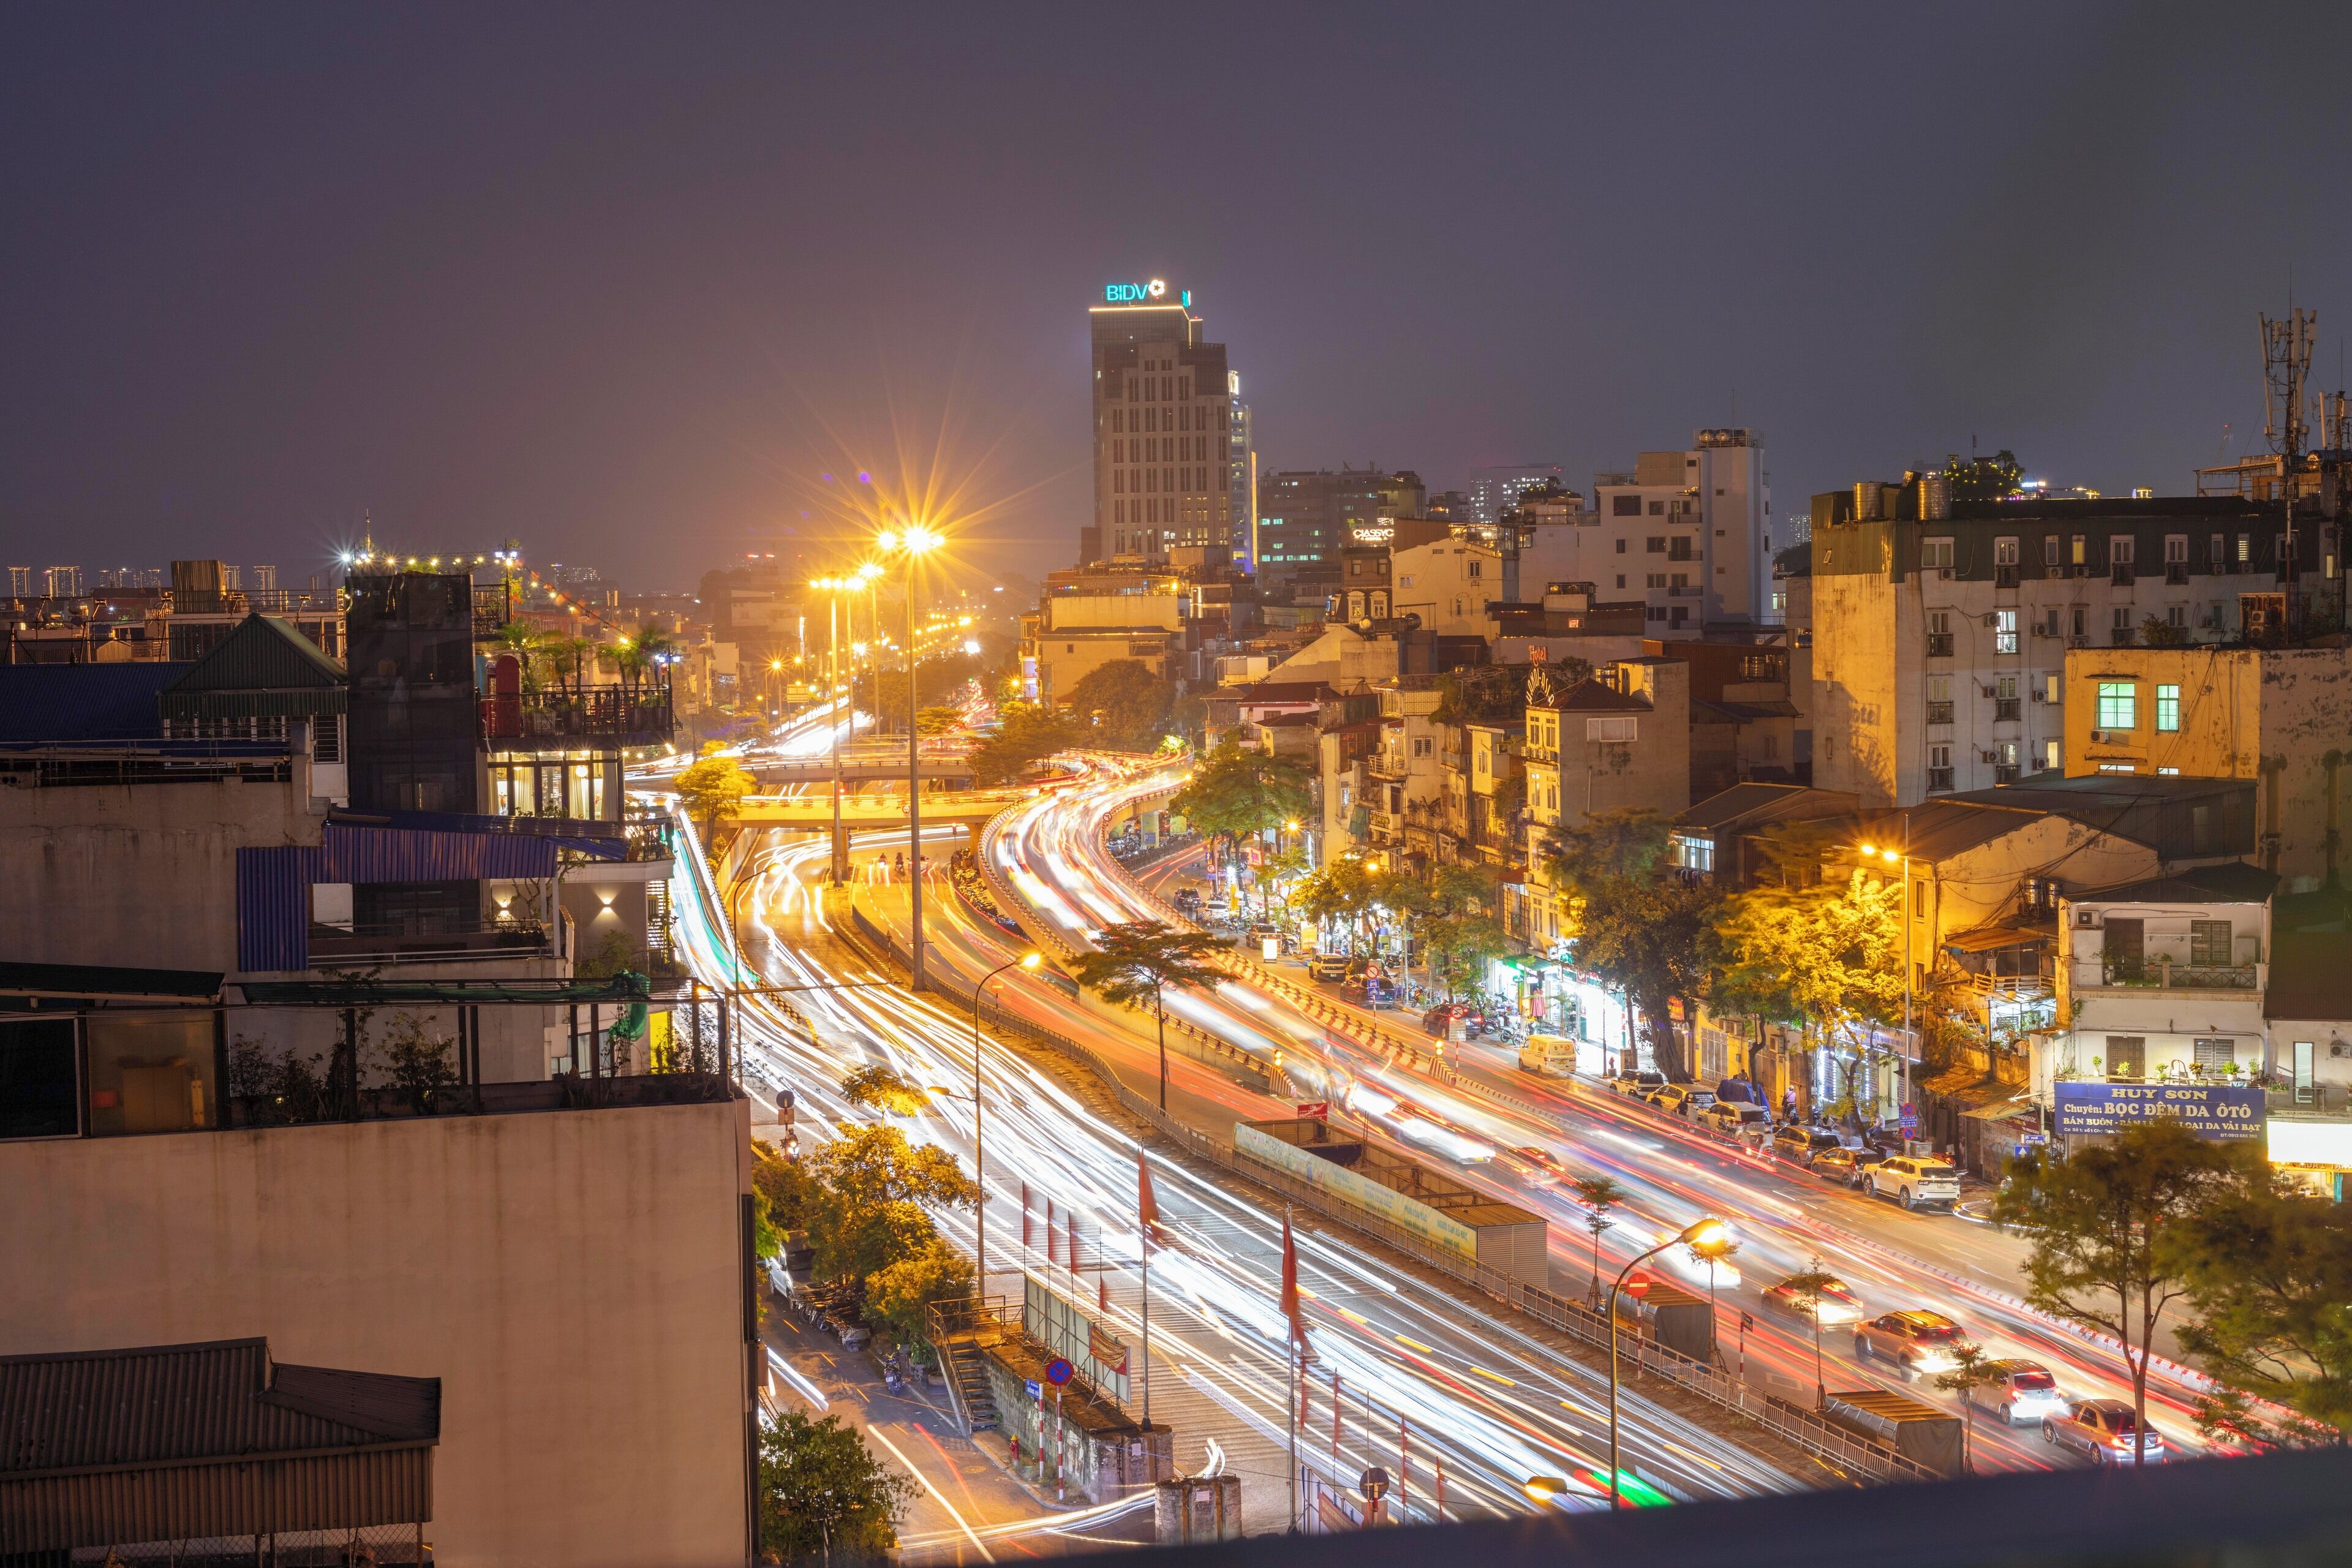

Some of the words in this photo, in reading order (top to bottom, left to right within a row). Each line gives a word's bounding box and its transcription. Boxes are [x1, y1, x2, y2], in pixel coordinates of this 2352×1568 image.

[1106, 284, 1148, 301] BIDV
[1529, 645, 1547, 667] Hotel
[2111, 1088, 2157, 1098] HUY
[2165, 1090, 2208, 1100] SƠN
[2064, 1103, 2102, 1114] Chuyên:
[2104, 1102, 2139, 1117] BỌC
[2144, 1101, 2180, 1118] ĐỆM
[2185, 1105, 2210, 1117] DA
[2216, 1102, 2252, 1118] ÔTÔ
[2063, 1116, 2084, 1125] BÁN
[2222, 1121, 2239, 1130] VẢI
[2242, 1123, 2261, 1133] BẠT
